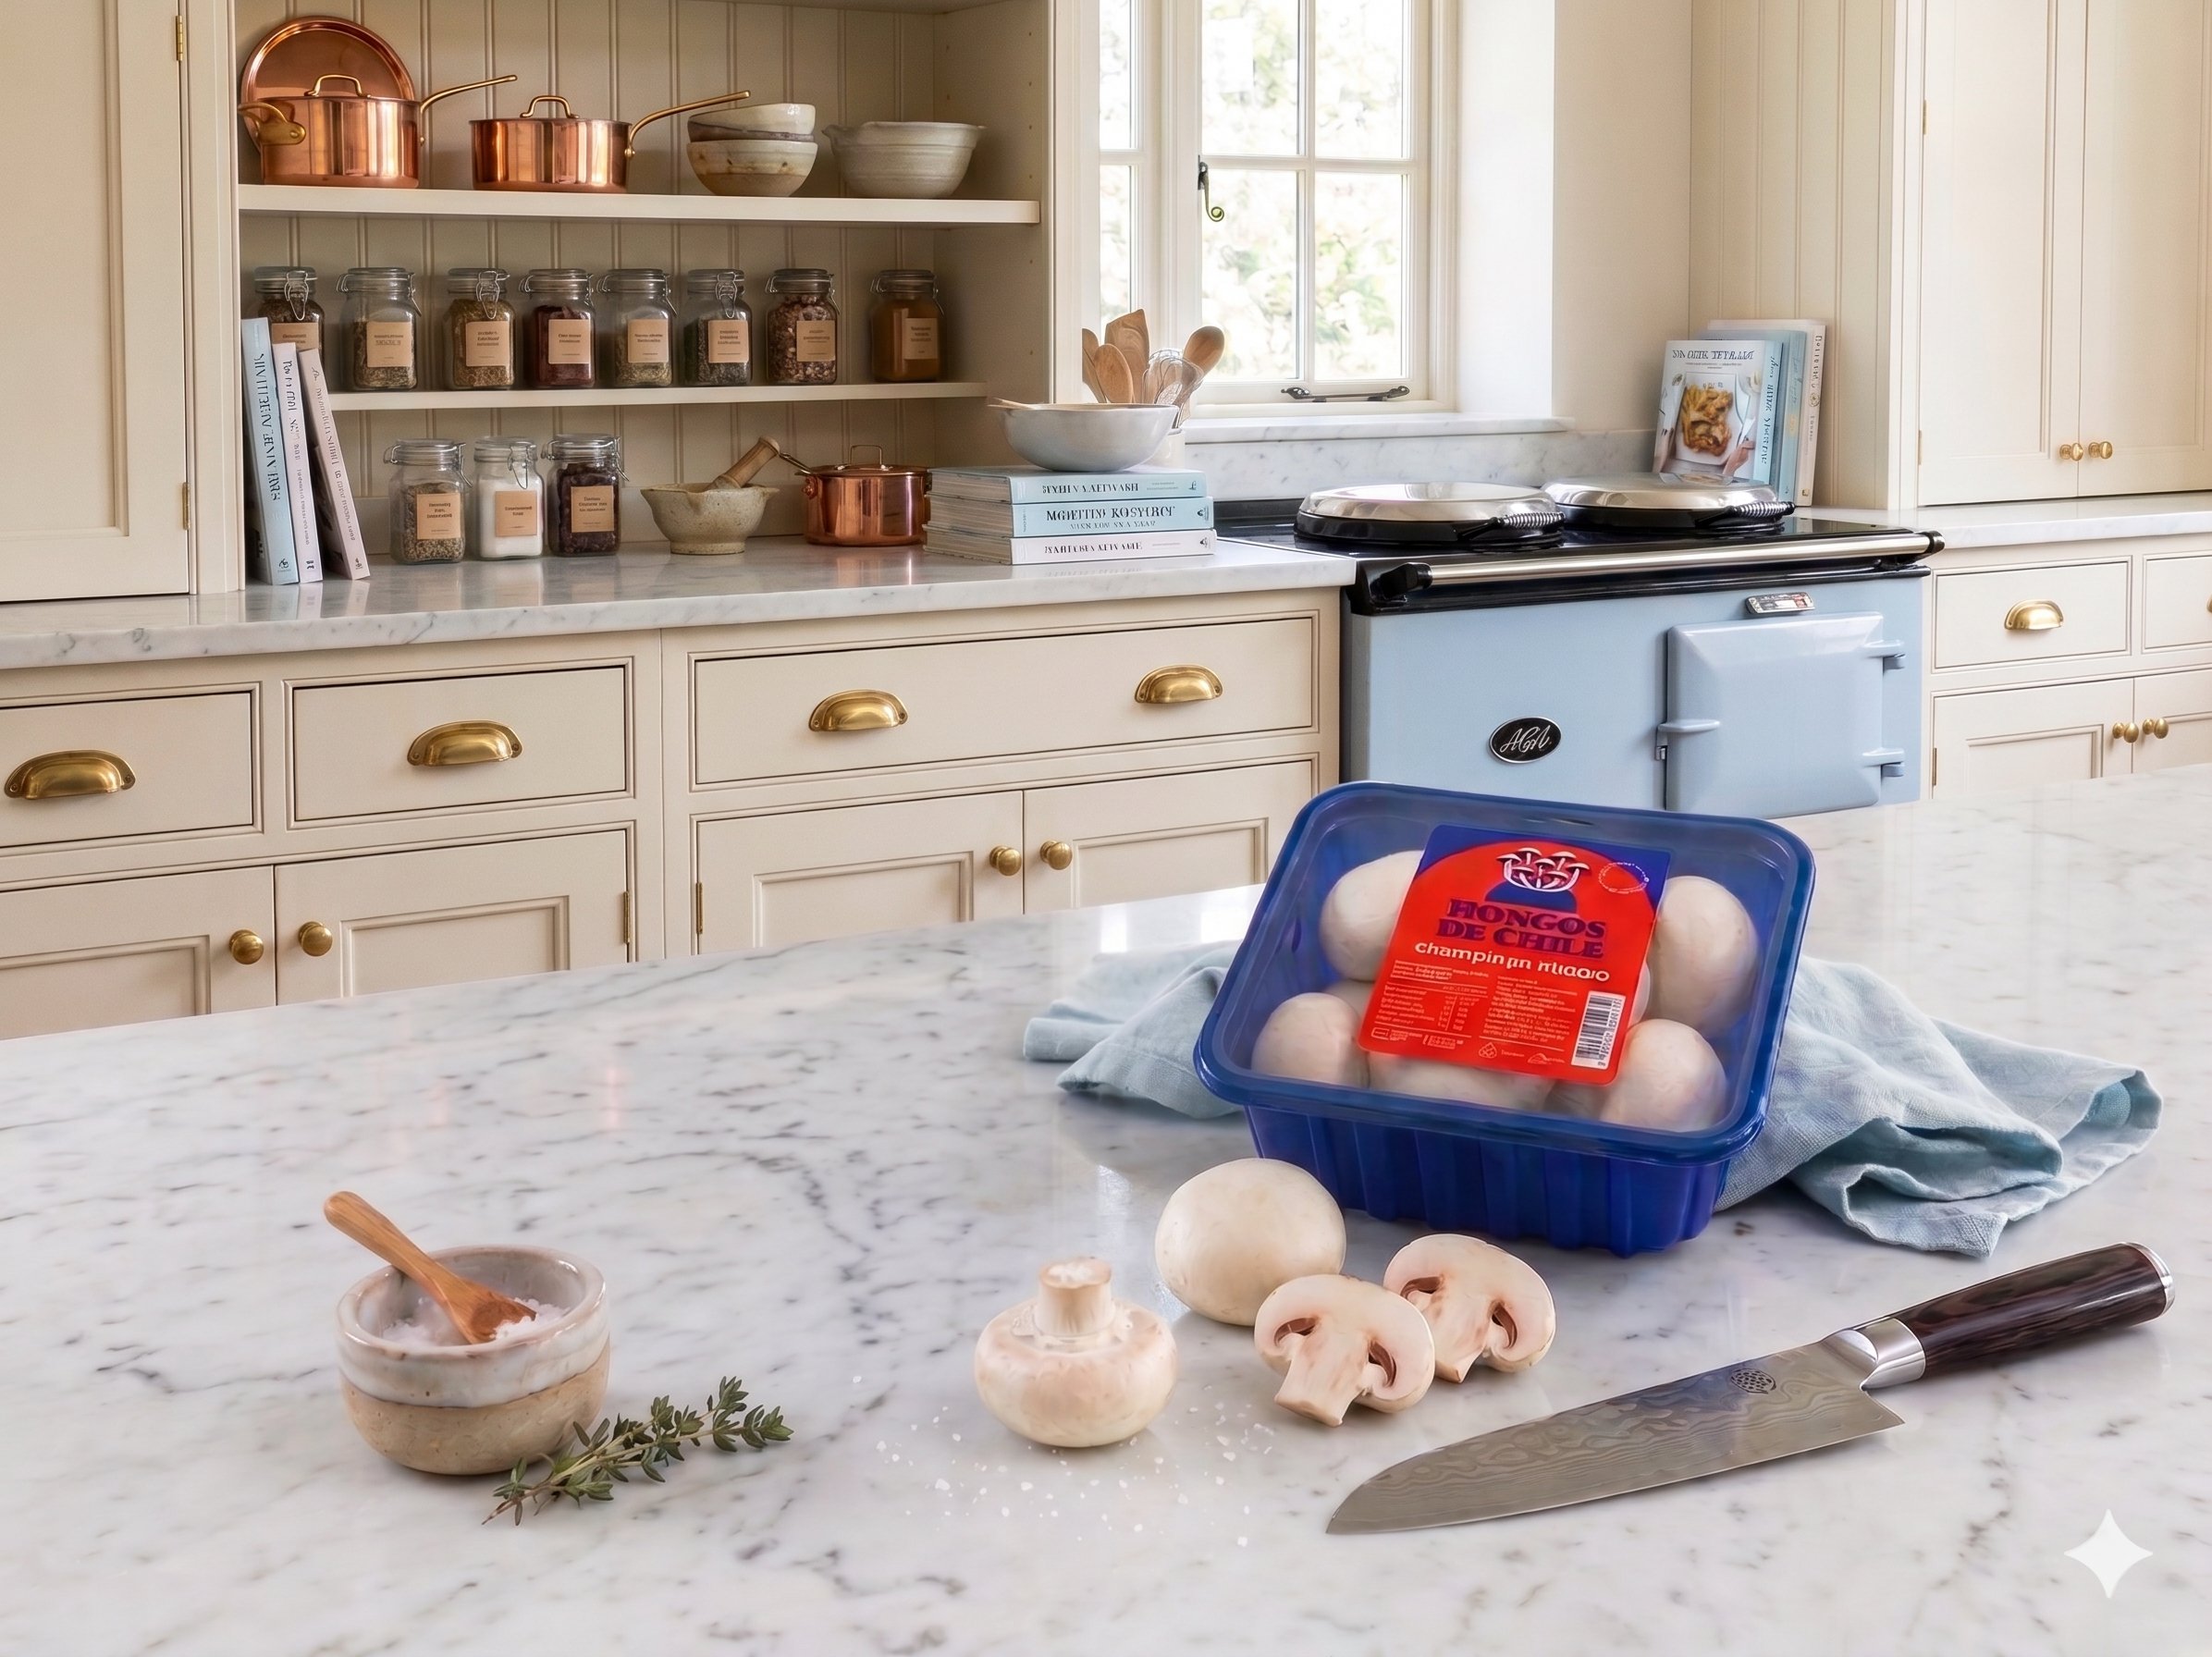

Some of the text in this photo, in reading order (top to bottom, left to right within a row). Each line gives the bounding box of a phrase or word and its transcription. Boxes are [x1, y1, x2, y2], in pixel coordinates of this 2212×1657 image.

[1435, 917, 1604, 959] DE CHILE
[1447, 898, 1606, 939] HONGOS
